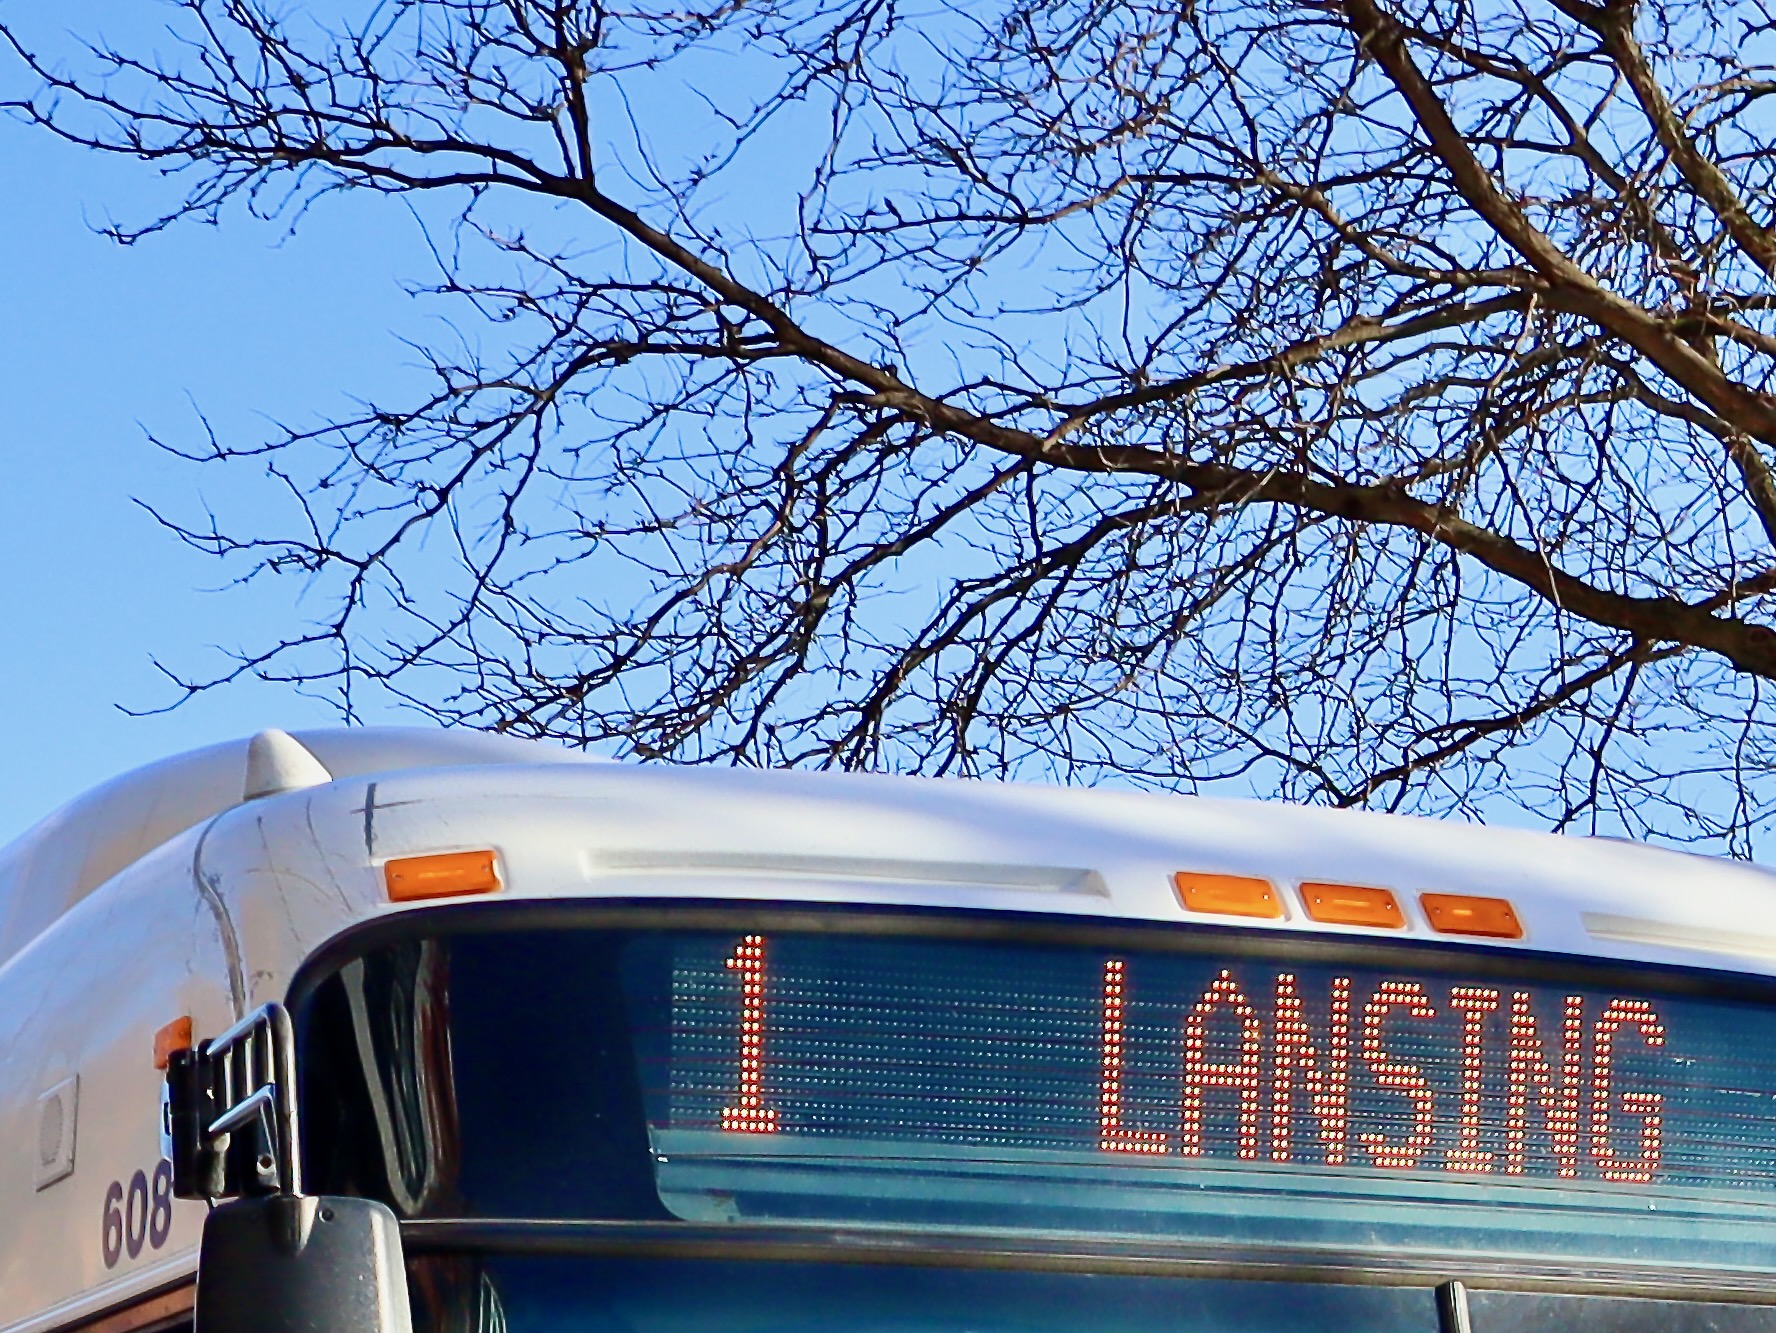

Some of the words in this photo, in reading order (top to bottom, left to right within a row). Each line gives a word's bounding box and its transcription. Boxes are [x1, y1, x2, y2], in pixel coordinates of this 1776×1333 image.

[721, 935, 776, 1132] 1
[1100, 959, 1665, 1182] LANSING
[103, 1158, 172, 1270] 608
